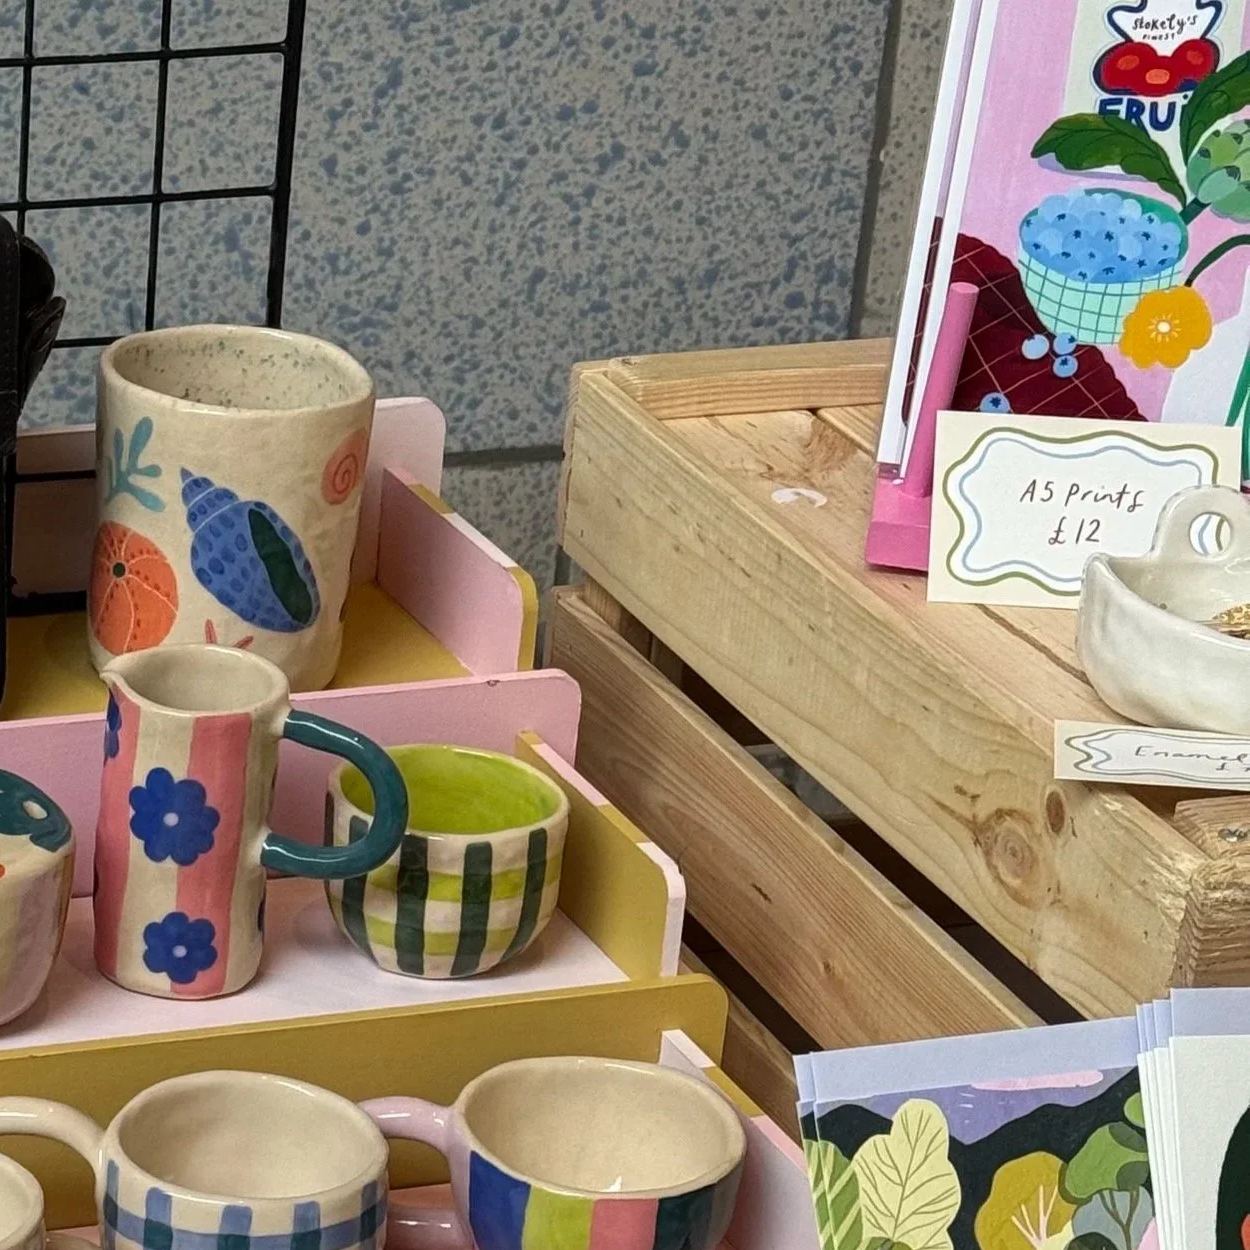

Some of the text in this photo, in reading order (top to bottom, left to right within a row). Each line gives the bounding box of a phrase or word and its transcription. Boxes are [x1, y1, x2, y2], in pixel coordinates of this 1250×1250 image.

[1019, 479, 1145, 513] A5 Prints
[1047, 516, 1101, 545] £12
